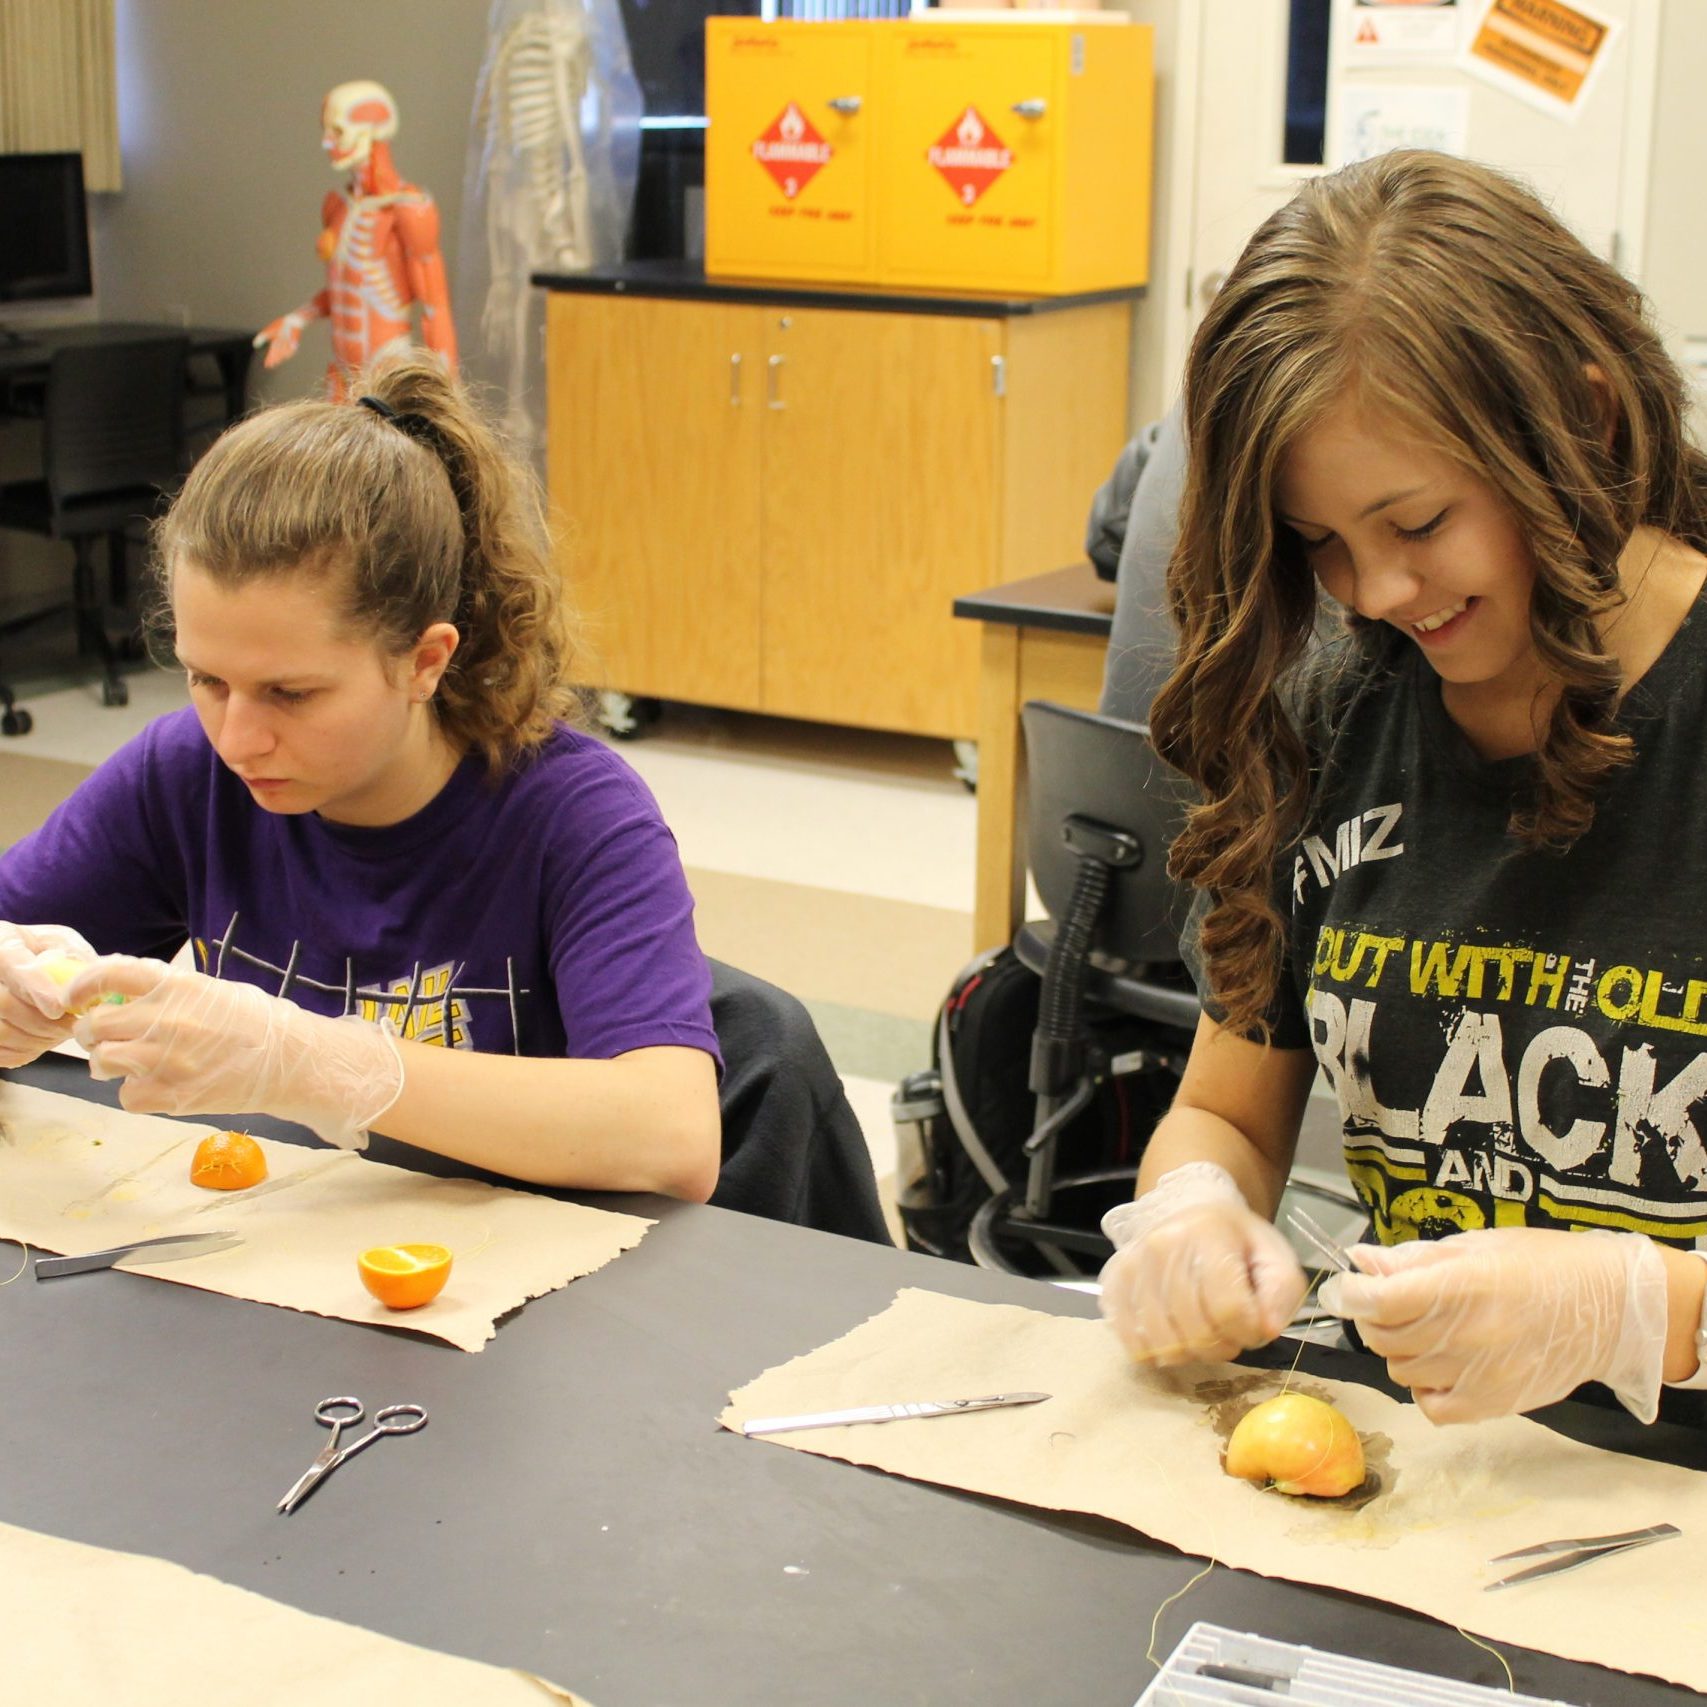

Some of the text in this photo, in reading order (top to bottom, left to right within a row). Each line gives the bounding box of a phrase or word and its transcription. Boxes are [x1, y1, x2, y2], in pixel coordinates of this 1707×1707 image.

[752, 140, 831, 163] FLAMMABLE
[928, 146, 1012, 169] FLAMMABLE
[961, 182, 977, 206] 3
[1302, 802, 1404, 888] MIZ
[1314, 925, 1405, 988] OUT
[1410, 940, 1571, 1010] WITH
[1564, 957, 1597, 1014] THE
[1306, 989, 1707, 1193] BLACK
[1433, 1148, 1535, 1202] AND
